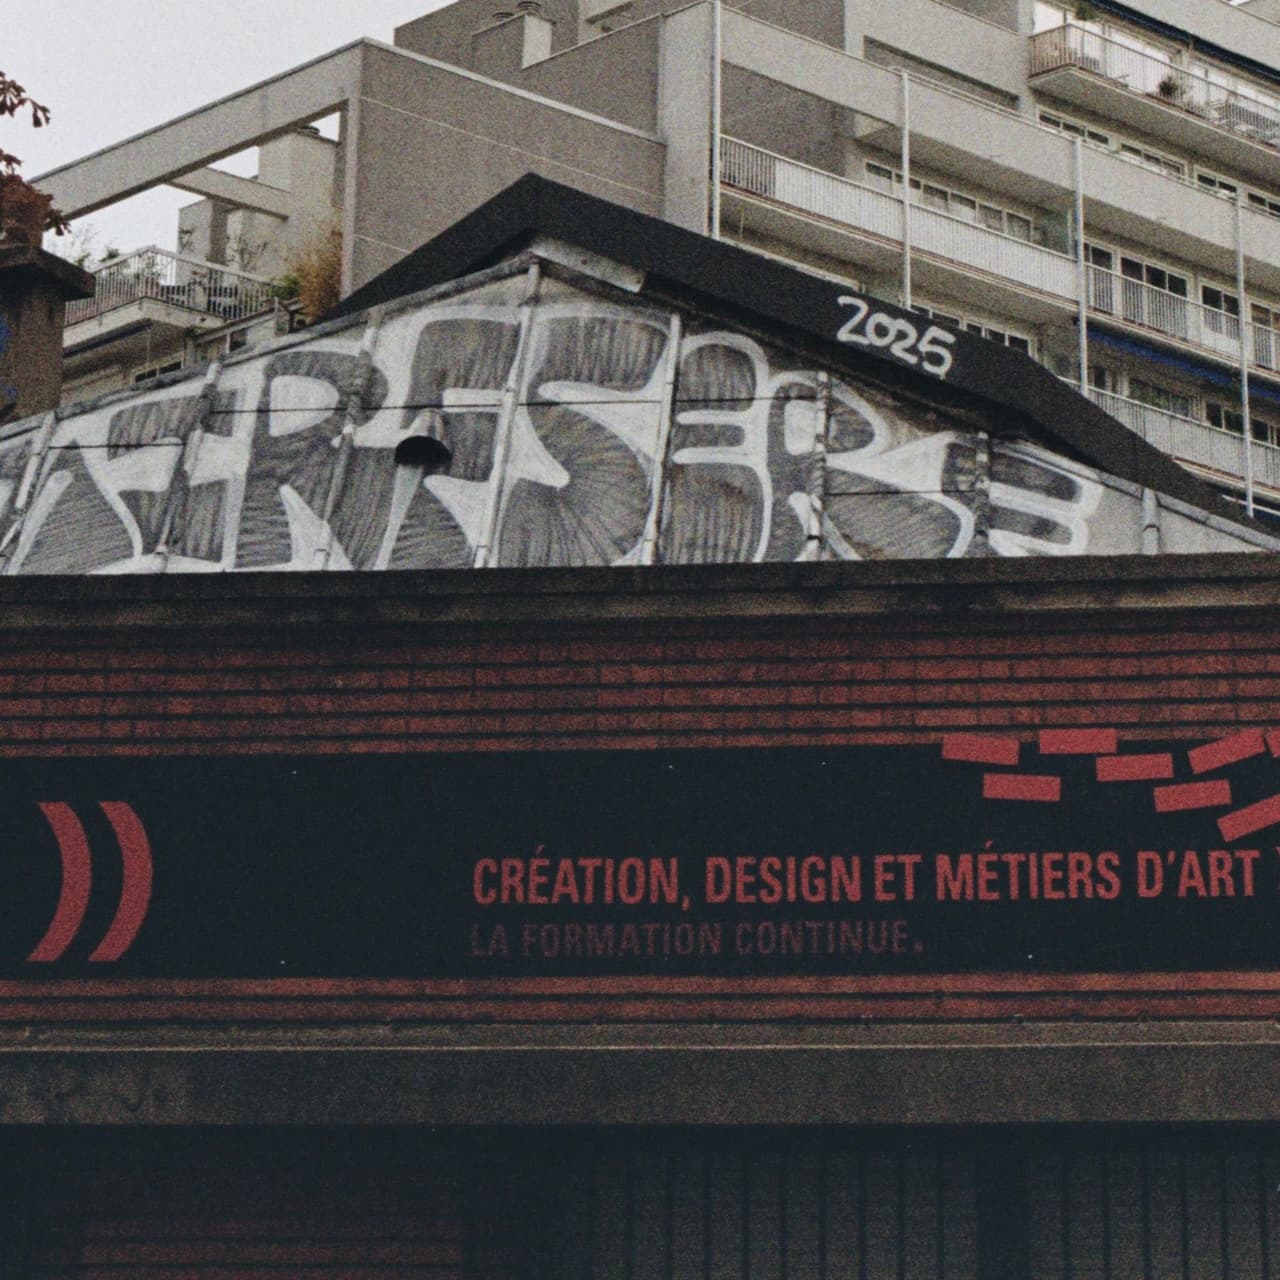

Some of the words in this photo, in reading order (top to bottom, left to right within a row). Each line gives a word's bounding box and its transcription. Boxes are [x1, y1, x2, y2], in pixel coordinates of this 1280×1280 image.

[837, 295, 956, 381] 2025
[473, 846, 691, 911] CRÉATION,
[705, 855, 862, 904] DESIGN
[874, 853, 923, 902] ET
[935, 839, 1122, 901] MÉTIERS
[1136, 848, 1261, 898] D'ART
[470, 924, 510, 958] LA
[523, 922, 722, 957] FORMATION
[735, 920, 925, 955] CONTINUE.
